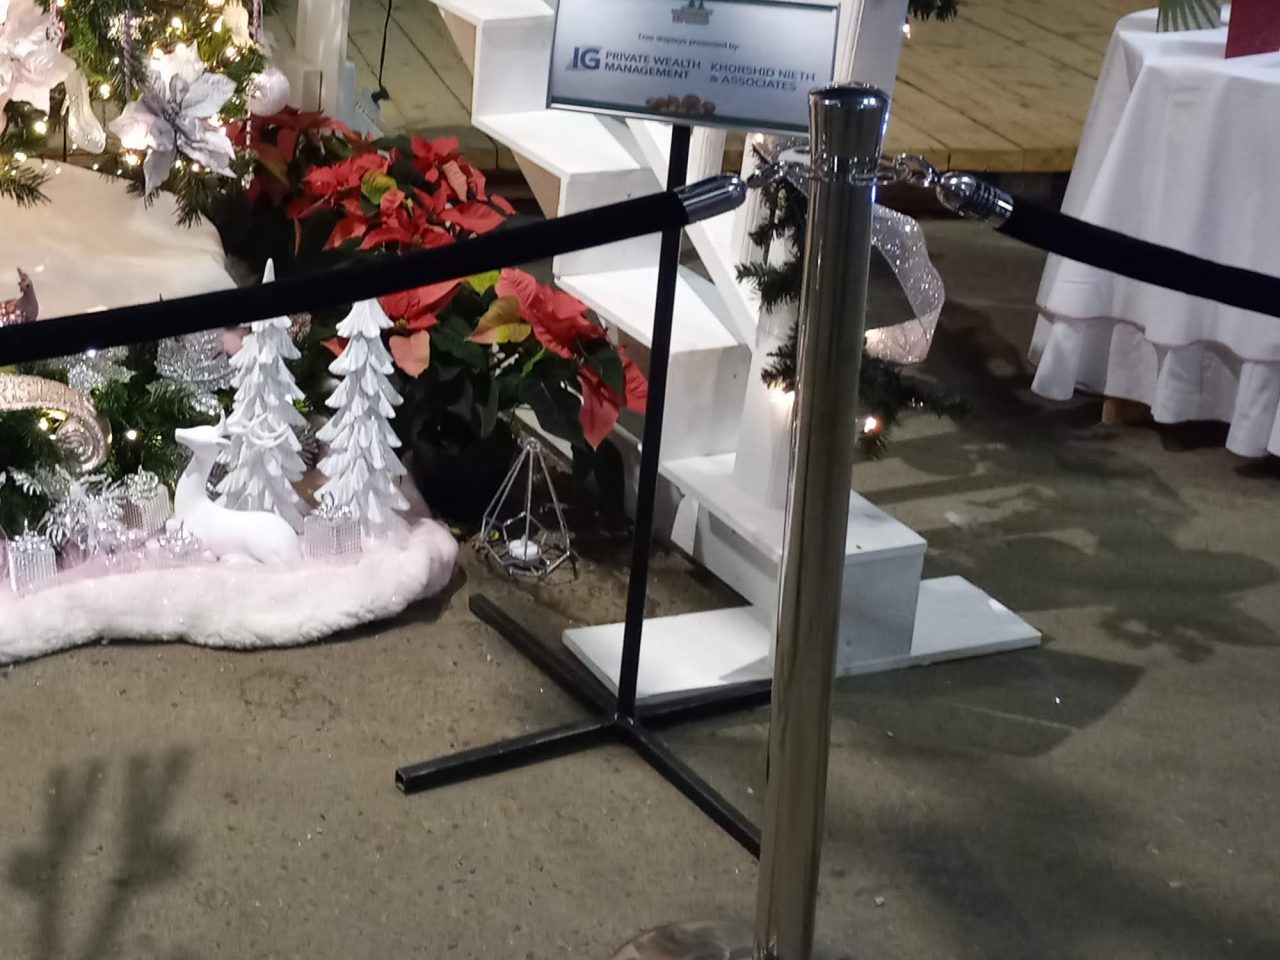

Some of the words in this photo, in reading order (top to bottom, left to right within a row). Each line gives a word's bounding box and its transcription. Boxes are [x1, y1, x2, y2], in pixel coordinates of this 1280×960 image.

[571, 45, 601, 71] IG
[605, 51, 649, 63] PRIVATE
[653, 56, 701, 68] WEALTH
[604, 62, 689, 78] MANAGEMENT
[710, 63, 774, 76] KHORSHID
[721, 75, 797, 91] ASSOCIATES
